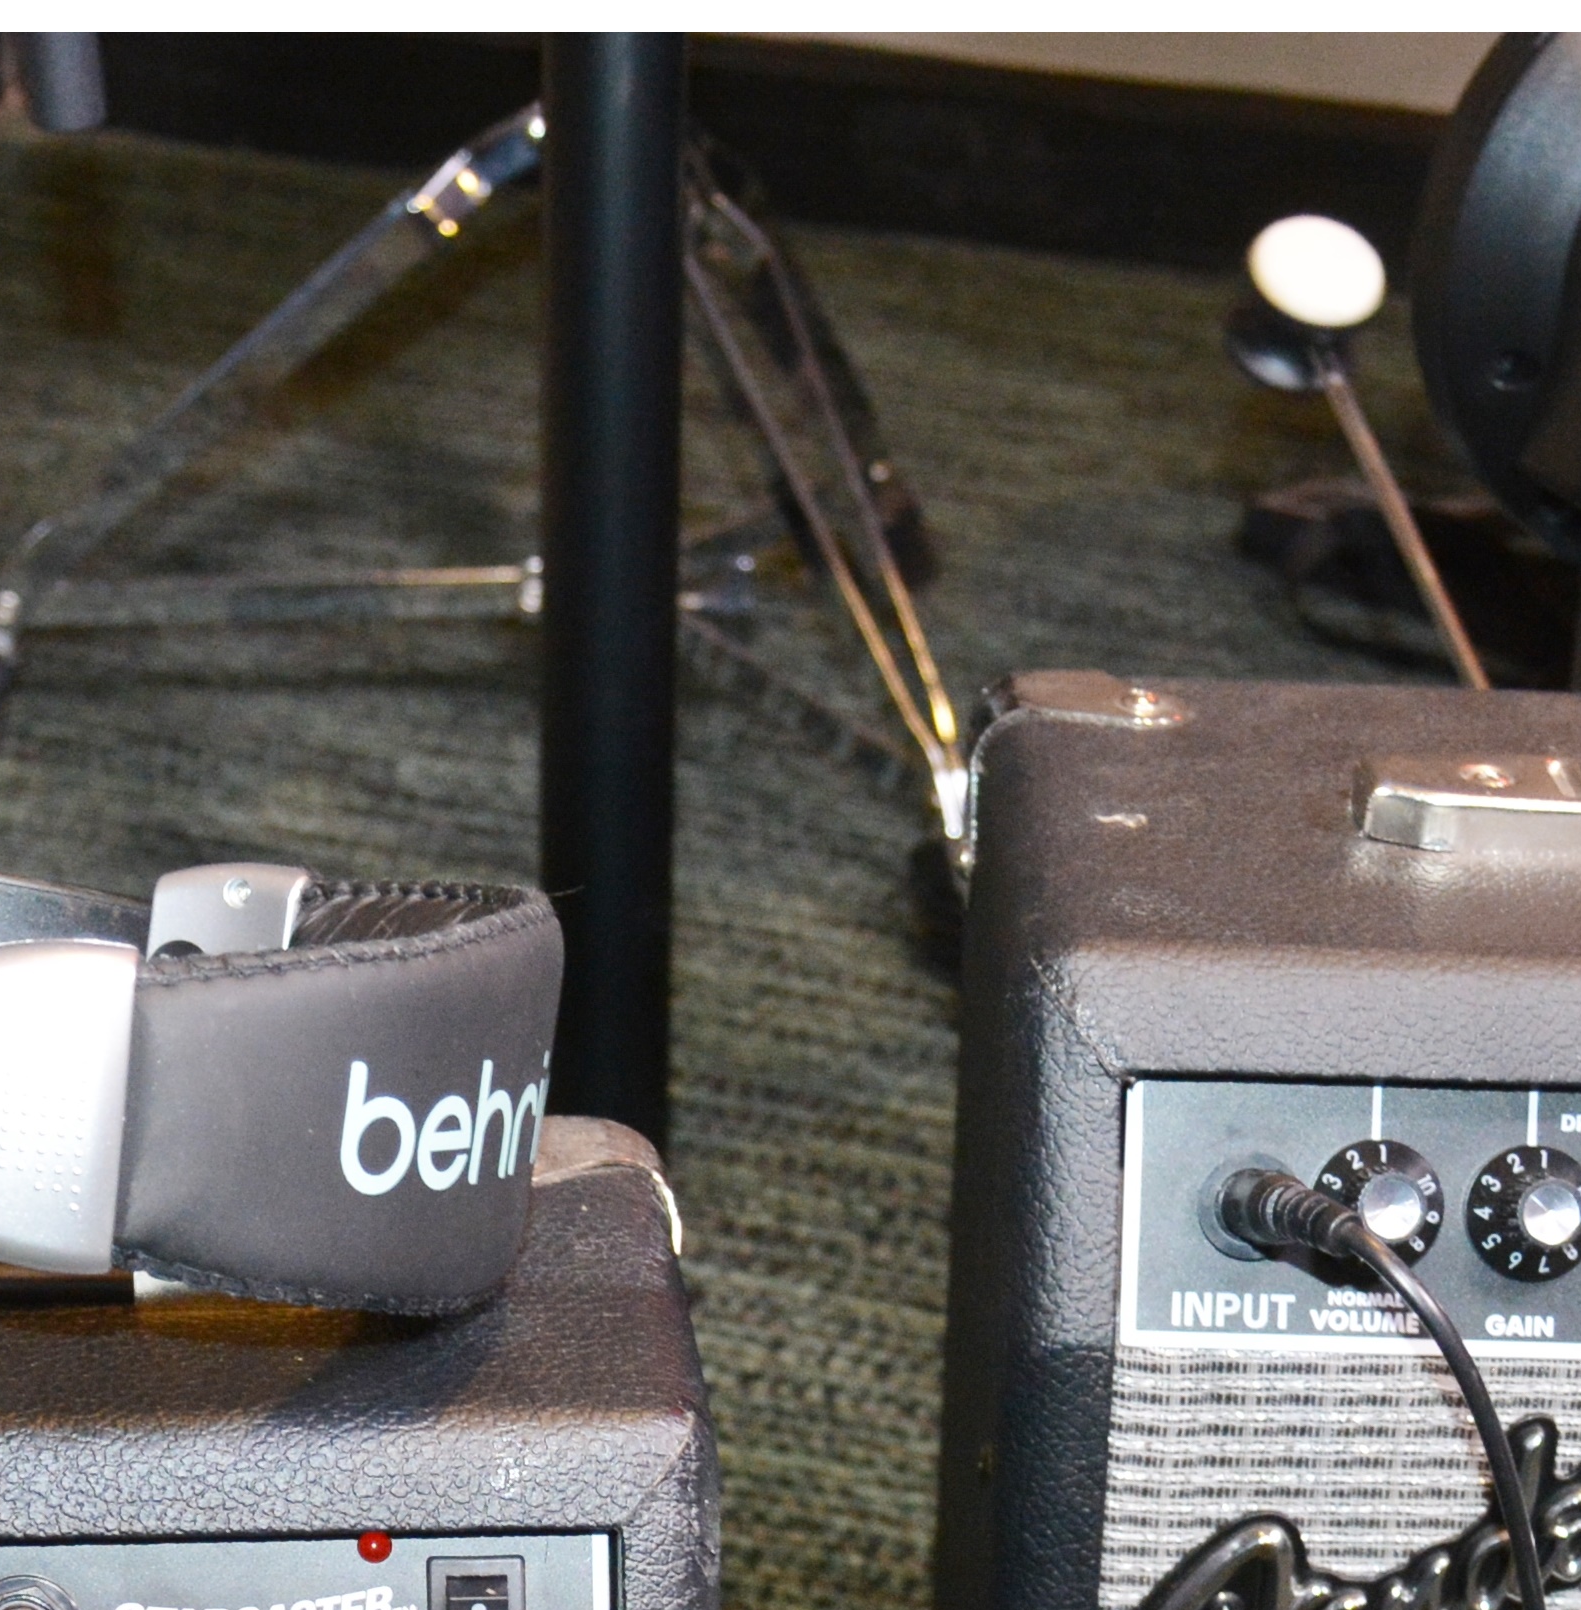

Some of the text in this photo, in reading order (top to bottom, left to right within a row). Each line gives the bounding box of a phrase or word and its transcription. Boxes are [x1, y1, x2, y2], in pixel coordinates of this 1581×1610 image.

[1346, 1150, 1364, 1170] 2
[1379, 1144, 1387, 1163] 1
[1540, 1150, 1548, 1169] 1
[1506, 1153, 1525, 1174] 2
[1322, 1173, 1342, 1190] 3
[1481, 1175, 1501, 1192] 3
[1473, 1206, 1493, 1220] 4
[1481, 1234, 1501, 1250] 5
[1508, 1252, 1522, 1270] 6
[1538, 1256, 1550, 1274] 7
[1328, 1291, 1404, 1308] NORMAL
[1170, 1291, 1296, 1330] INPUT
[1309, 1309, 1419, 1333] VOLUME
[1485, 1314, 1554, 1338] GAIN
